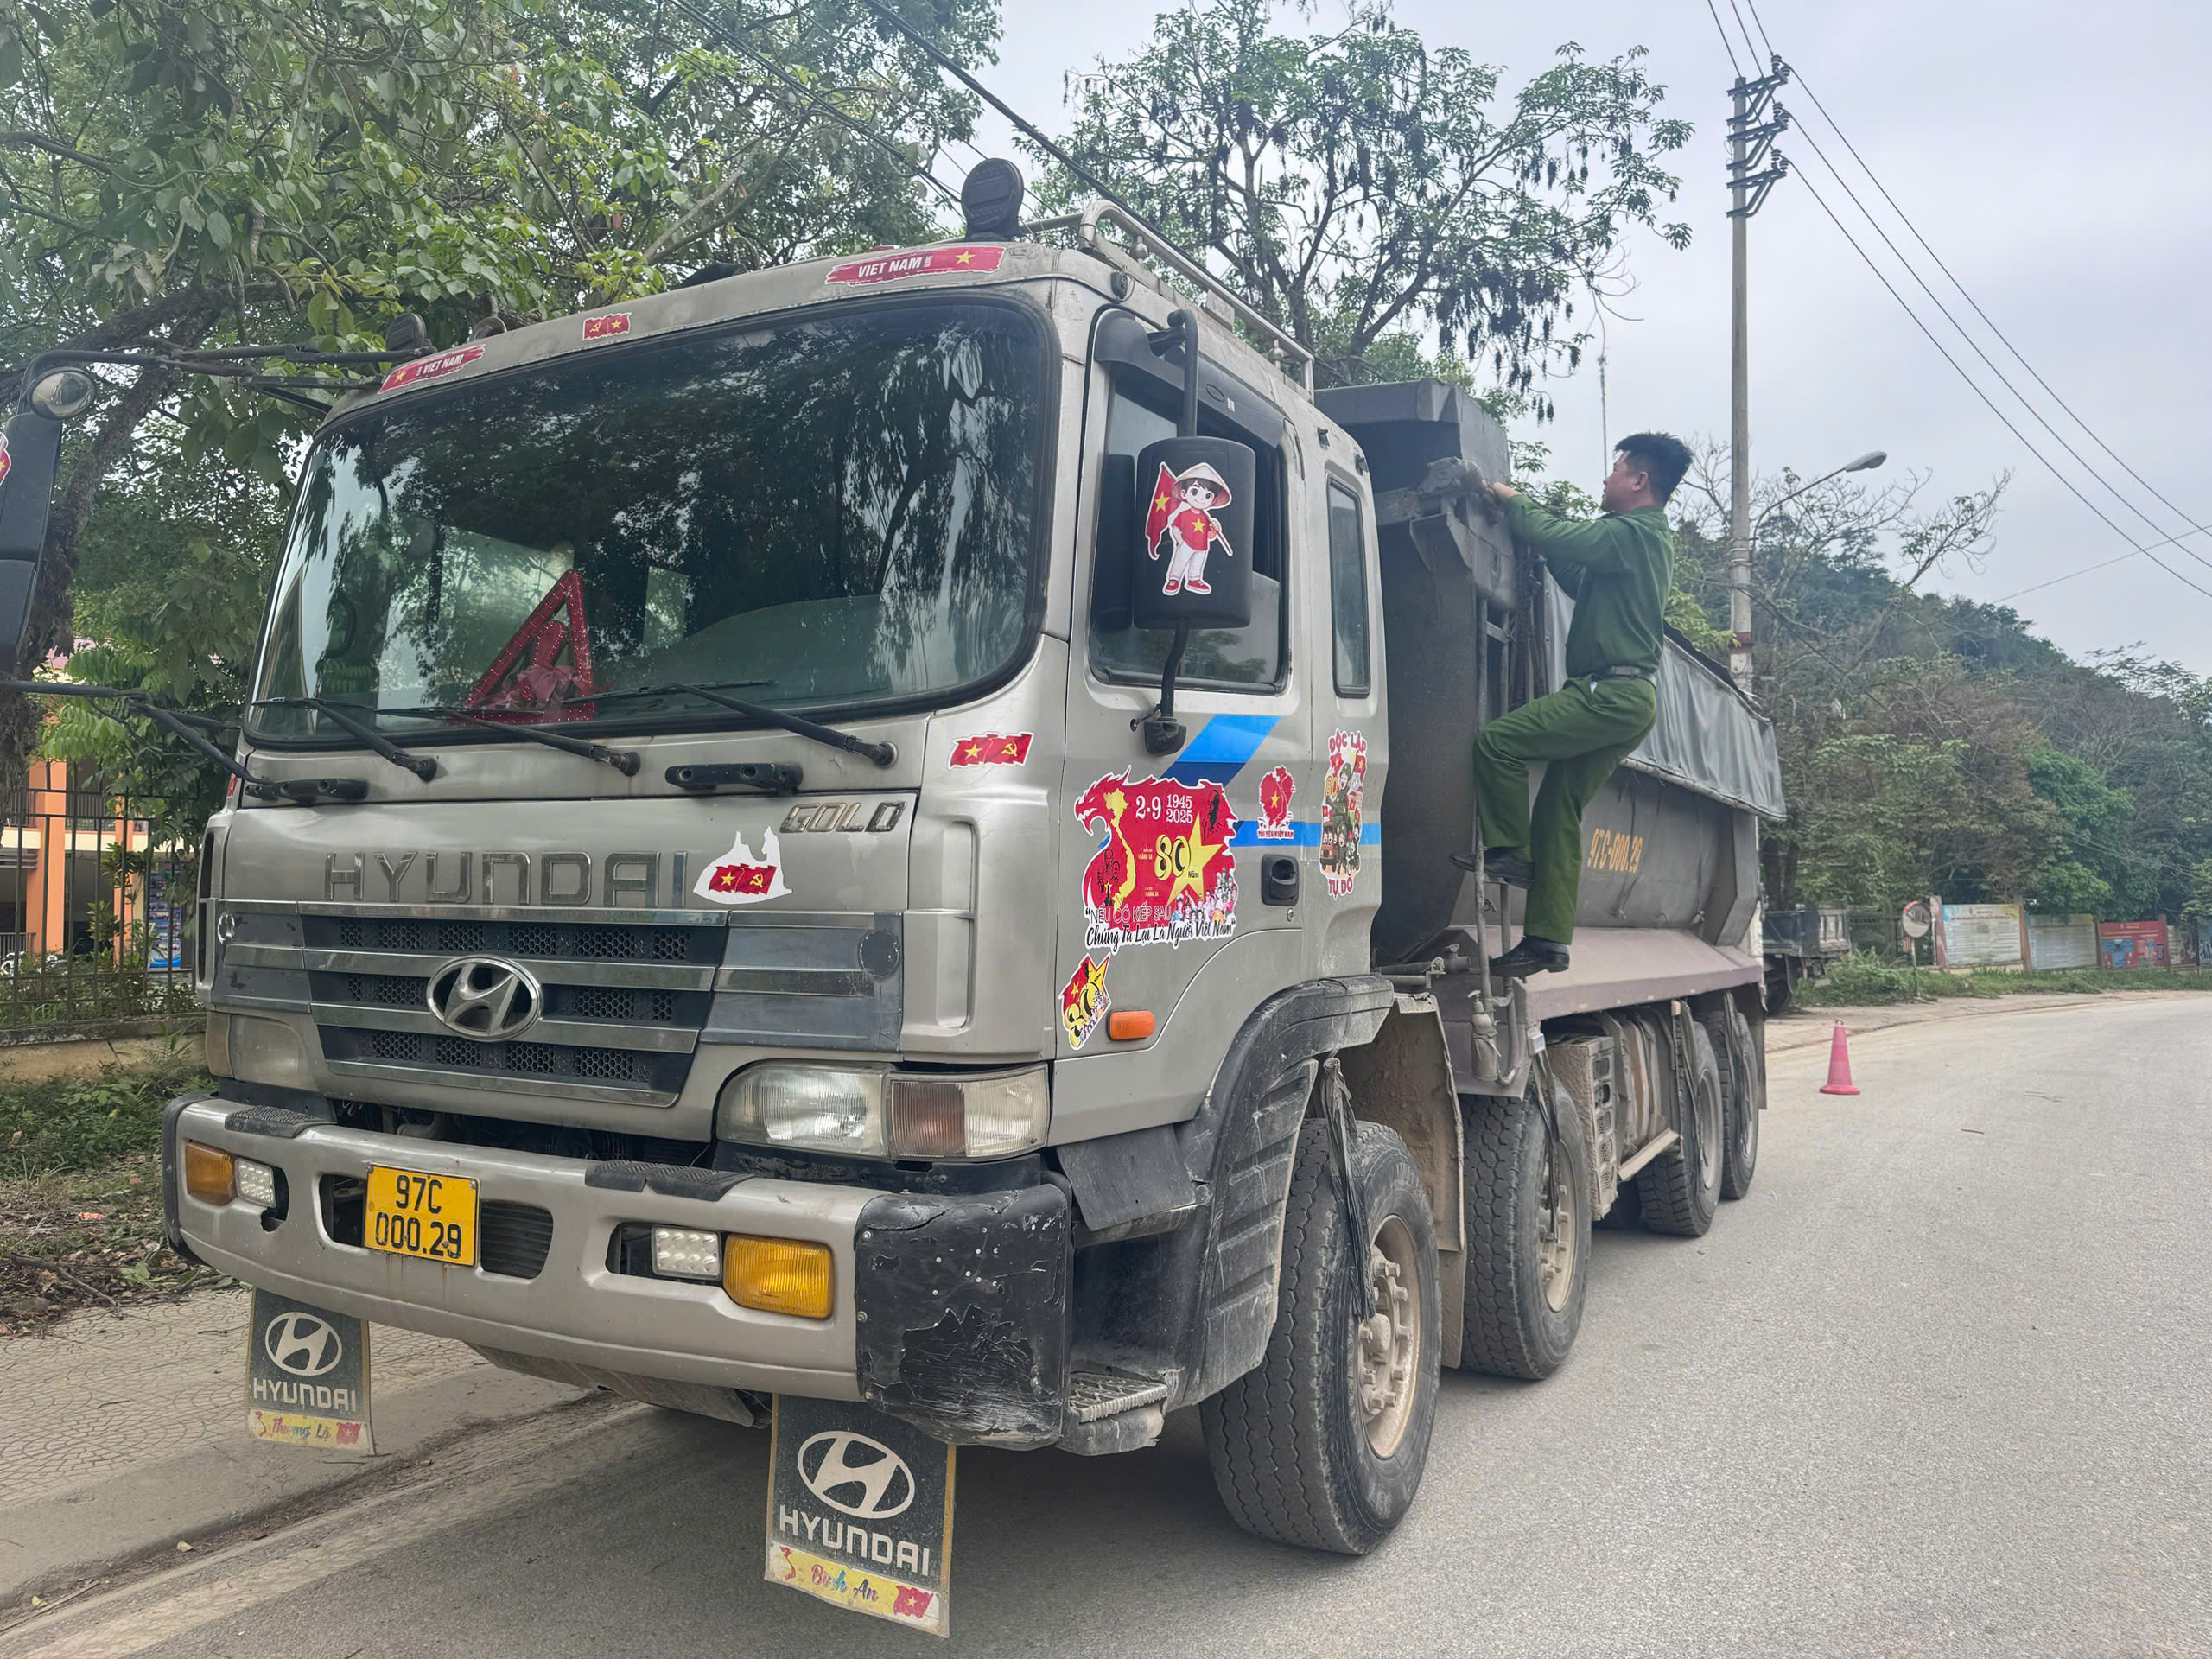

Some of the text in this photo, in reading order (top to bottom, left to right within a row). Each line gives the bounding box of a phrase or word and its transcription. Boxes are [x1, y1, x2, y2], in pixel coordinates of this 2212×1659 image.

[858, 259, 887, 277] VIET
[888, 257, 924, 273] NAM
[423, 359, 443, 374] VIET
[442, 353, 465, 369] NAM
[1167, 794, 1192, 809] 1945
[779, 800, 908, 834] GOLD
[1166, 809, 1193, 823] 2025
[1154, 834, 1191, 880] 80
[324, 850, 689, 908] HYUNDAI
[1341, 877, 1352, 894] DO
[1154, 906, 1172, 921] SAU
[1087, 927, 1120, 951] Chúng
[1122, 925, 1133, 943] Ta
[1153, 923, 1166, 941] Là
[395, 1174, 442, 1214] 97C
[375, 1211, 461, 1259] 000.29
[253, 1376, 356, 1412] HYUNDAI
[779, 1504, 930, 1577] HYUNDAI
[853, 1578, 879, 1602] An
